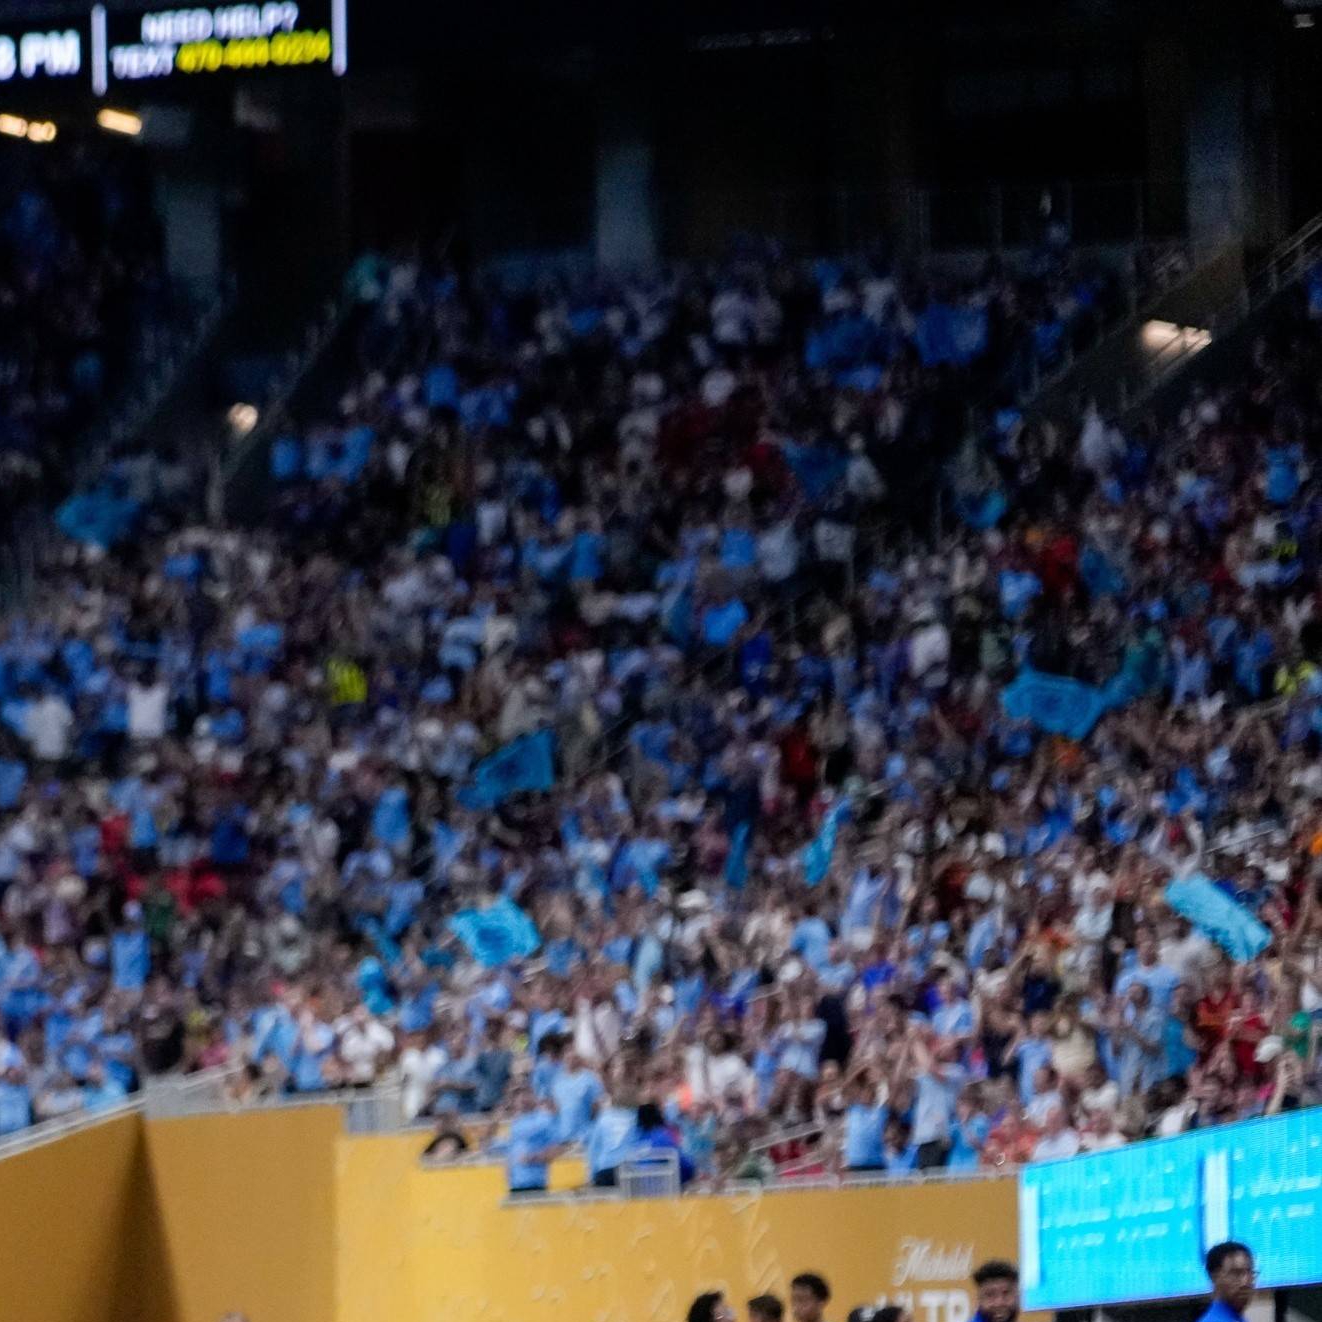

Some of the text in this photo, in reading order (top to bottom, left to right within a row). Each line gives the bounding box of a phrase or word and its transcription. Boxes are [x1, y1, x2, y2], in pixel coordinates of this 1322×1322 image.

[141, 2, 298, 43] NEED HELP?
[20, 28, 80, 78] PM
[109, 43, 176, 79] TEXT
